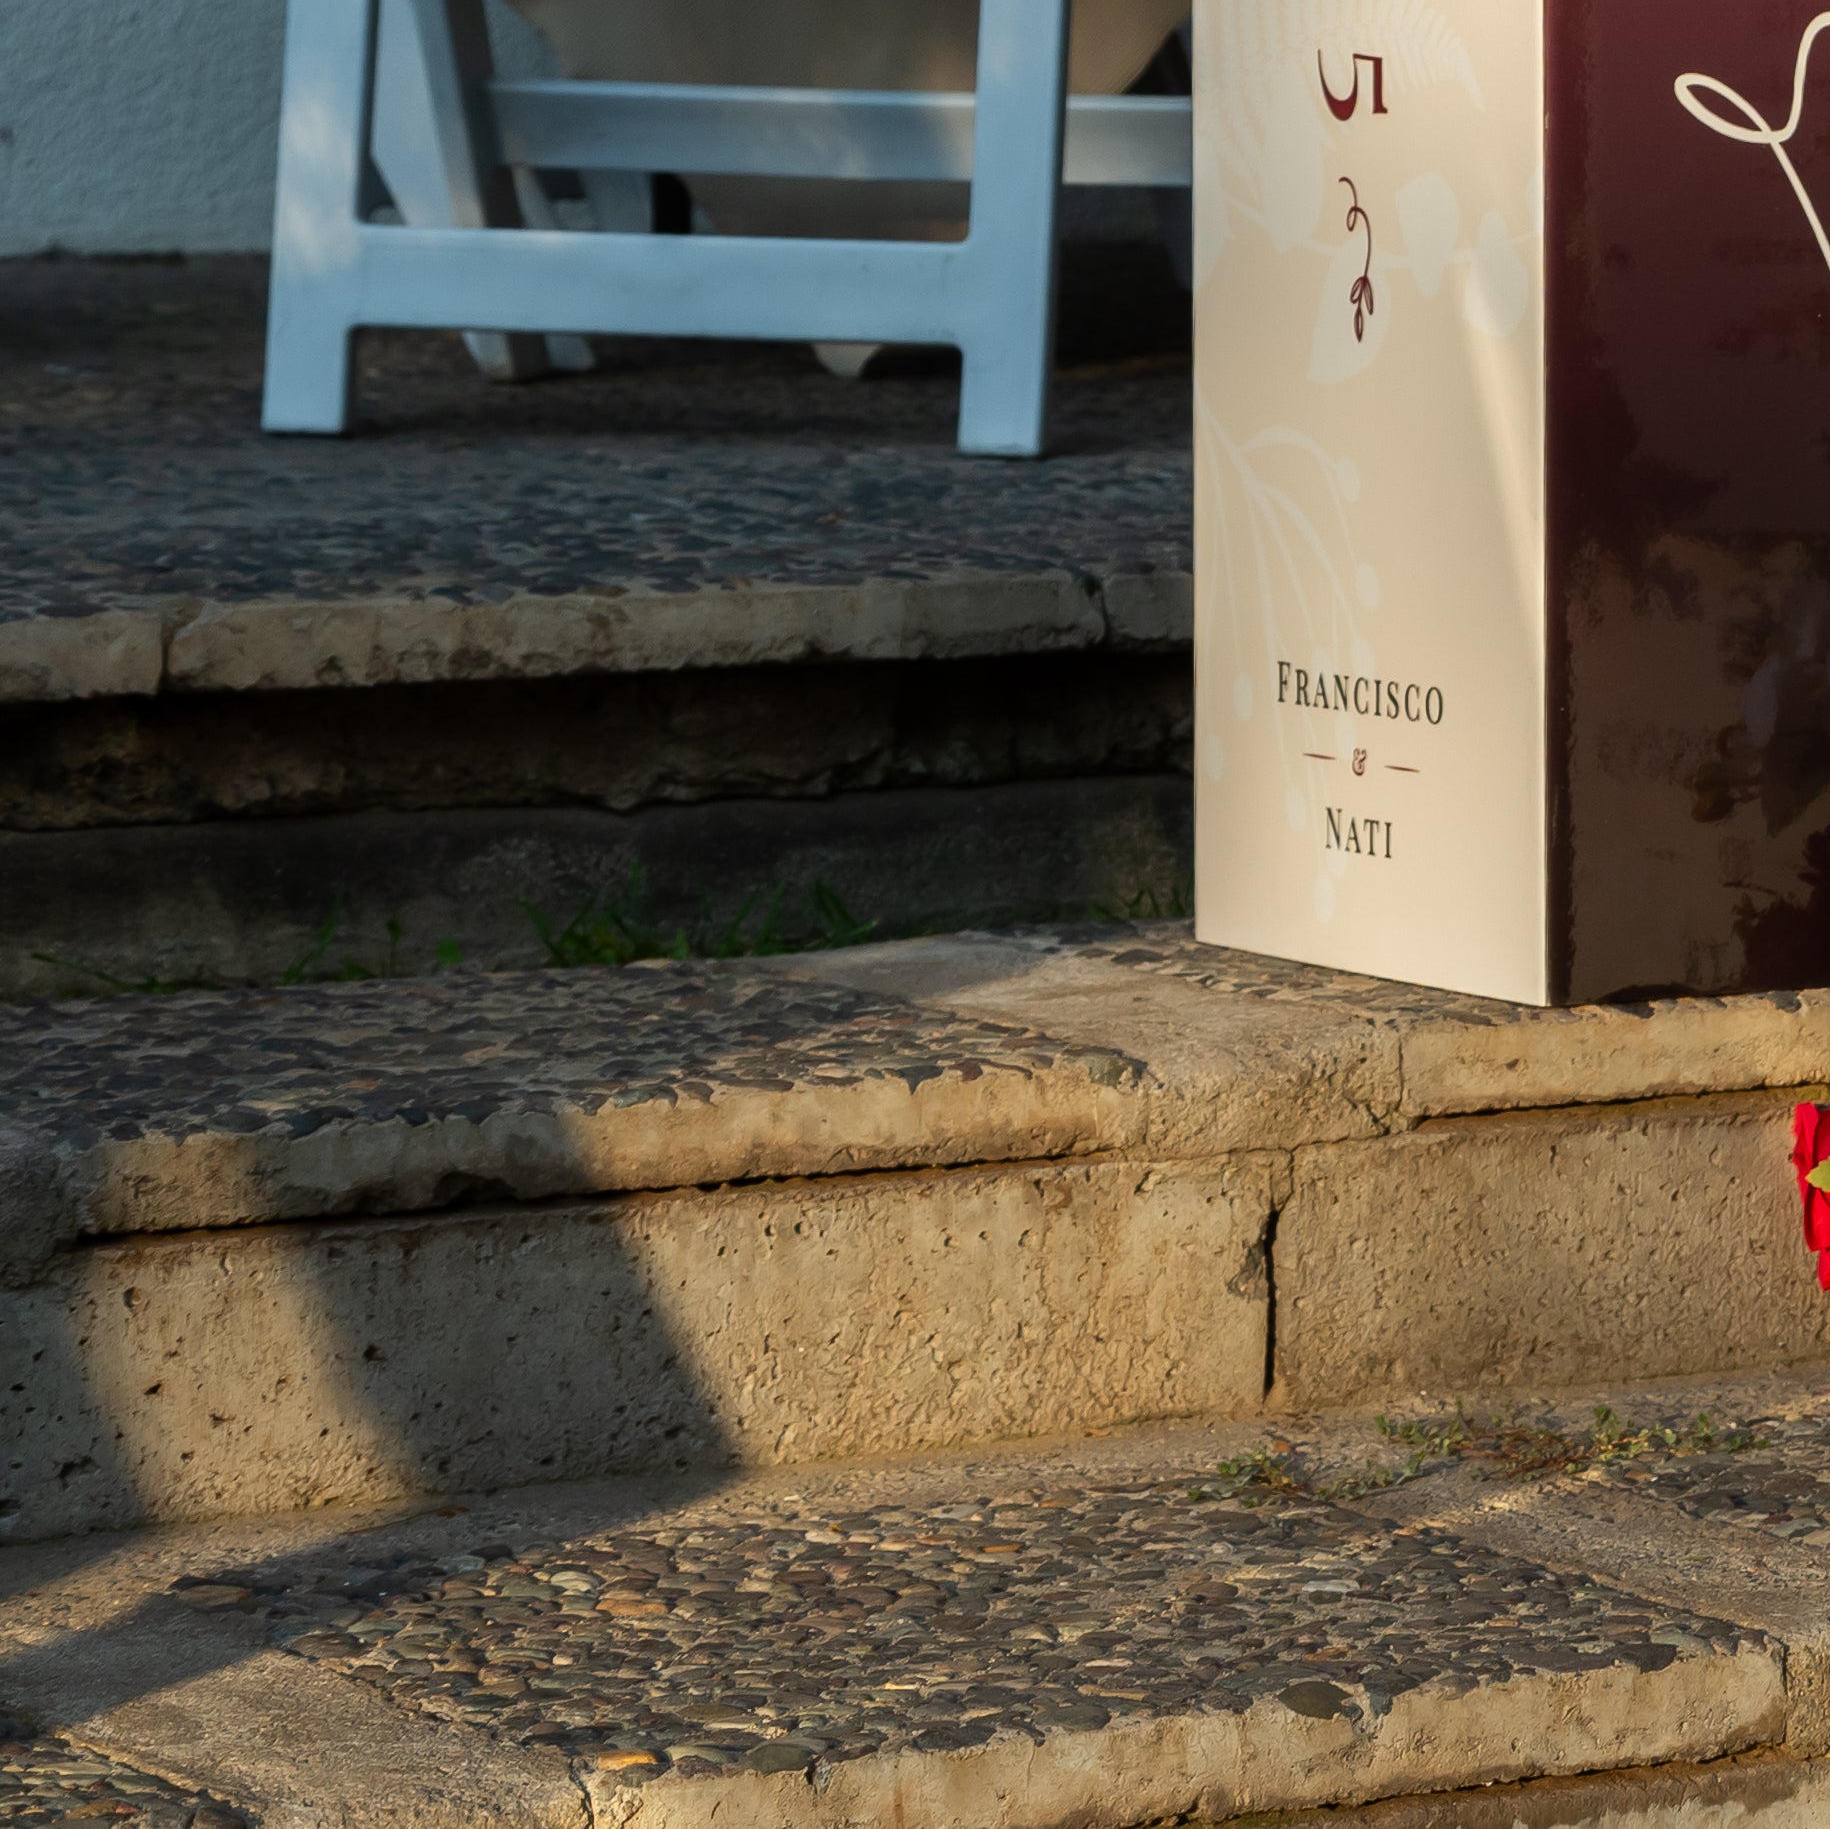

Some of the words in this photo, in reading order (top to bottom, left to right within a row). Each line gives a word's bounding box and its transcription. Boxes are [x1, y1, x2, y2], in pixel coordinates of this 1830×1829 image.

[1277, 660, 1444, 725] FRANCISCO
[1352, 748, 1367, 777] &
[1325, 807, 1392, 859] NATI
